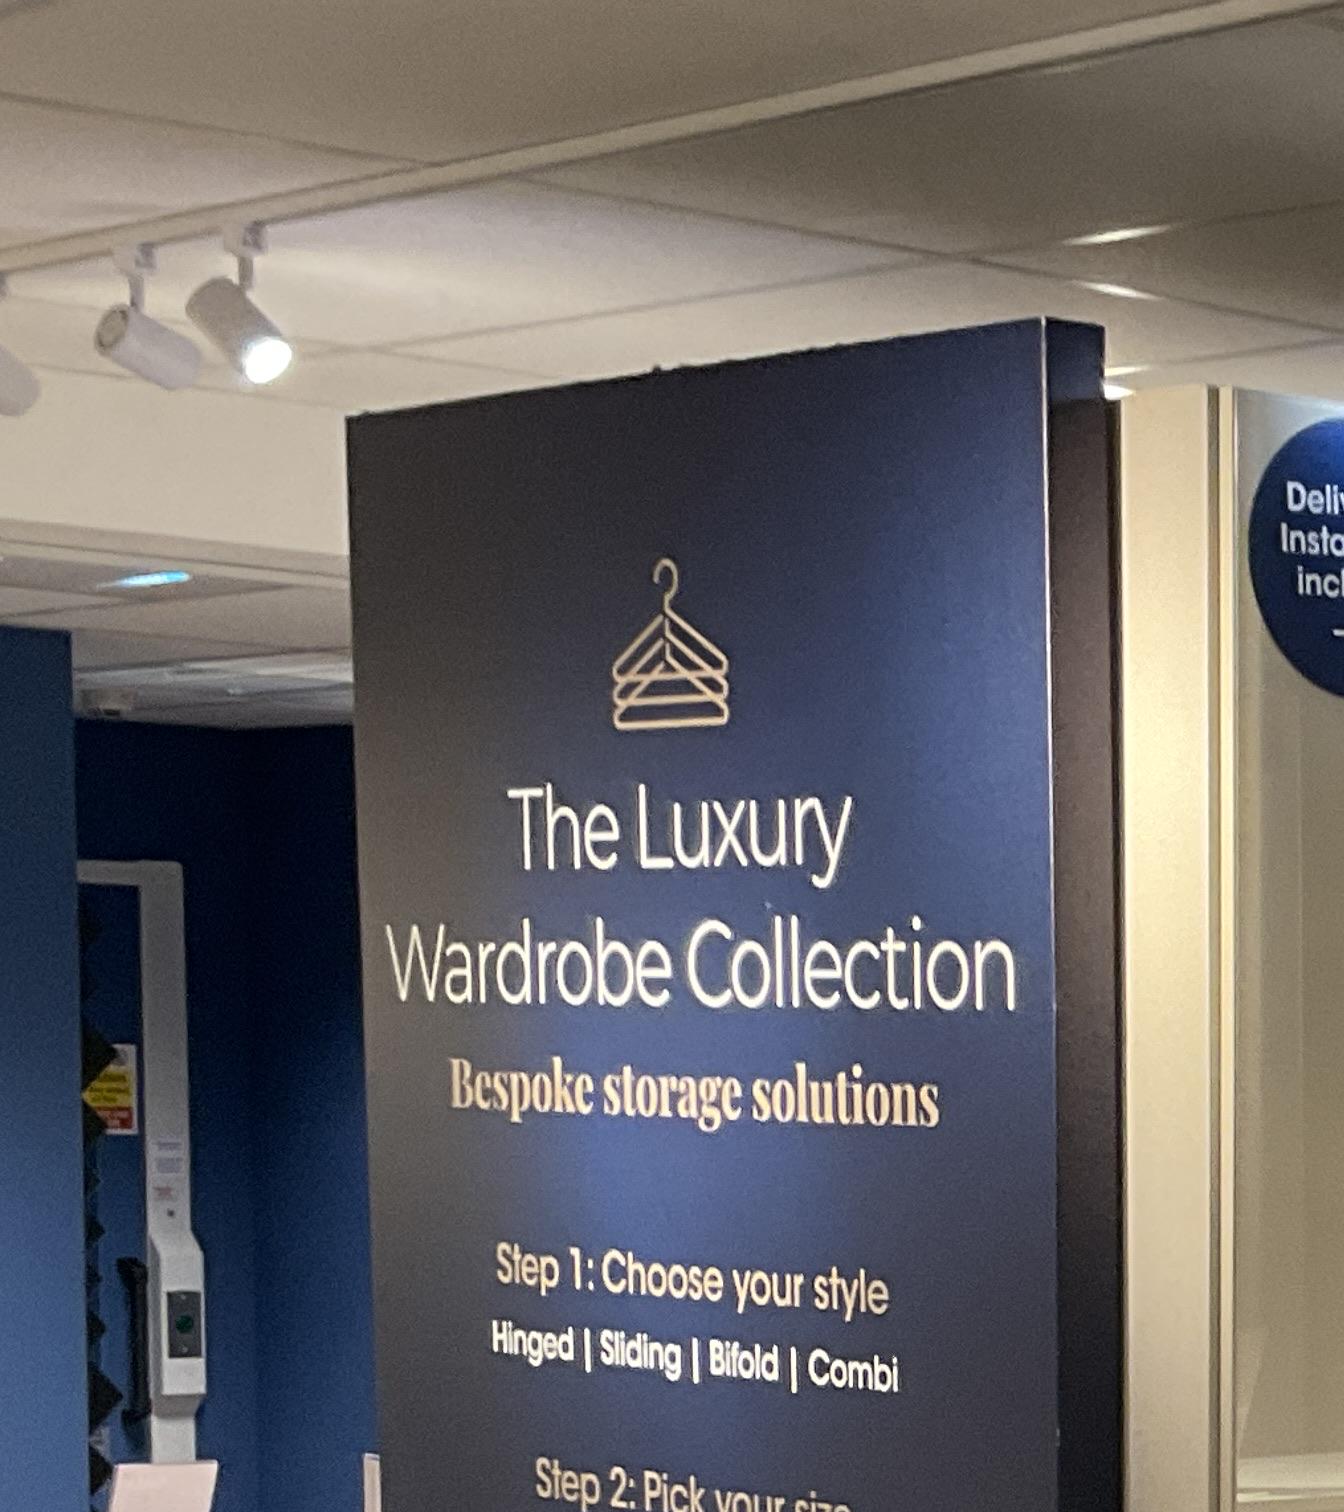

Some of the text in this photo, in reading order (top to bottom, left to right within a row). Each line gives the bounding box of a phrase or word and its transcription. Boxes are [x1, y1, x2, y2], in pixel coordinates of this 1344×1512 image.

[507, 783, 853, 889] The Luxury
[386, 915, 1015, 1012] Wardrobe Collection
[450, 1056, 939, 1133] Bespoke storage solutions
[496, 1241, 889, 1322] Step 1: Choose your style
[491, 1320, 574, 1367] Hinged
[599, 1330, 682, 1381] Sliding
[709, 1338, 779, 1382] Bifold
[807, 1350, 899, 1393] Combi
[535, 1457, 600, 1512] Step
[610, 1466, 636, 1510] 2:
